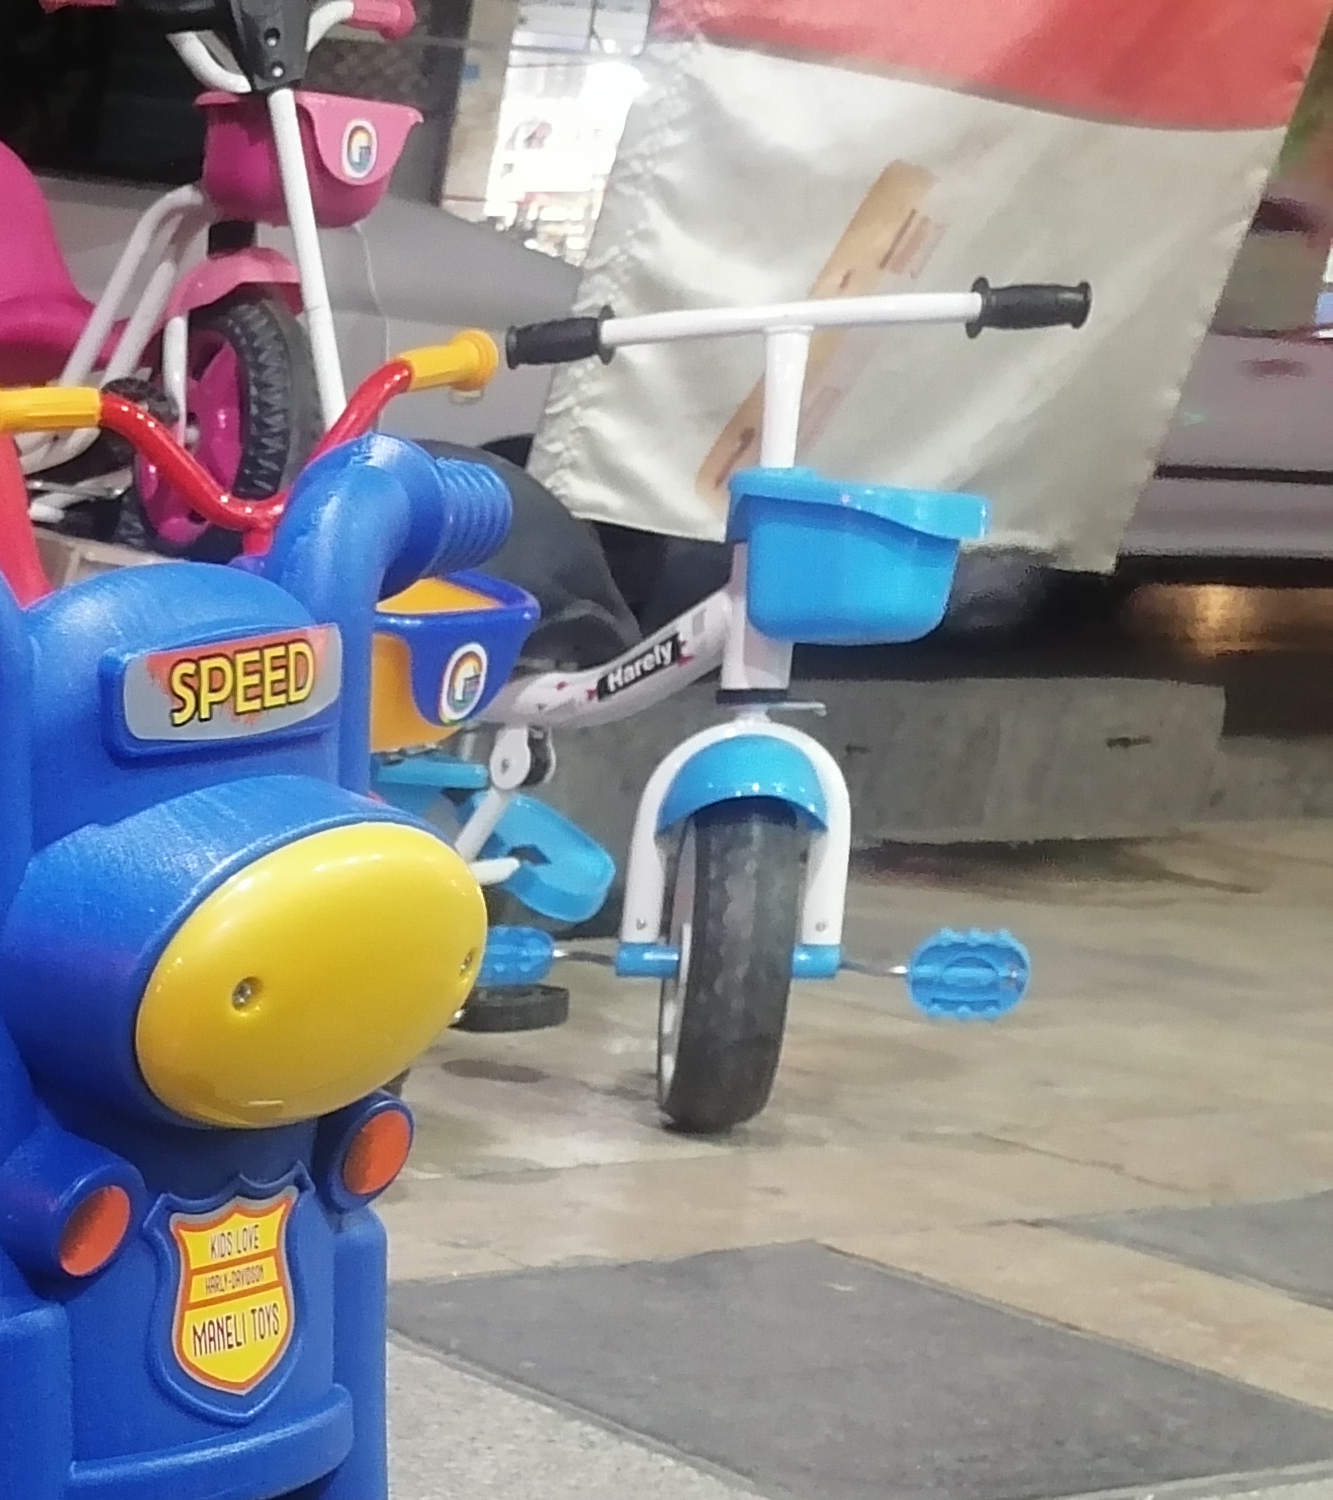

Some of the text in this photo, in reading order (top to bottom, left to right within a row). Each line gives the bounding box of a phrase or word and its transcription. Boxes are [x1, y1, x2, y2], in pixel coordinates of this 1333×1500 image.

[169, 638, 315, 727] SPEED
[607, 640, 673, 692] Harely
[210, 1224, 261, 1260] KIDS LOVE
[192, 1302, 281, 1357] MANELI TOYS
